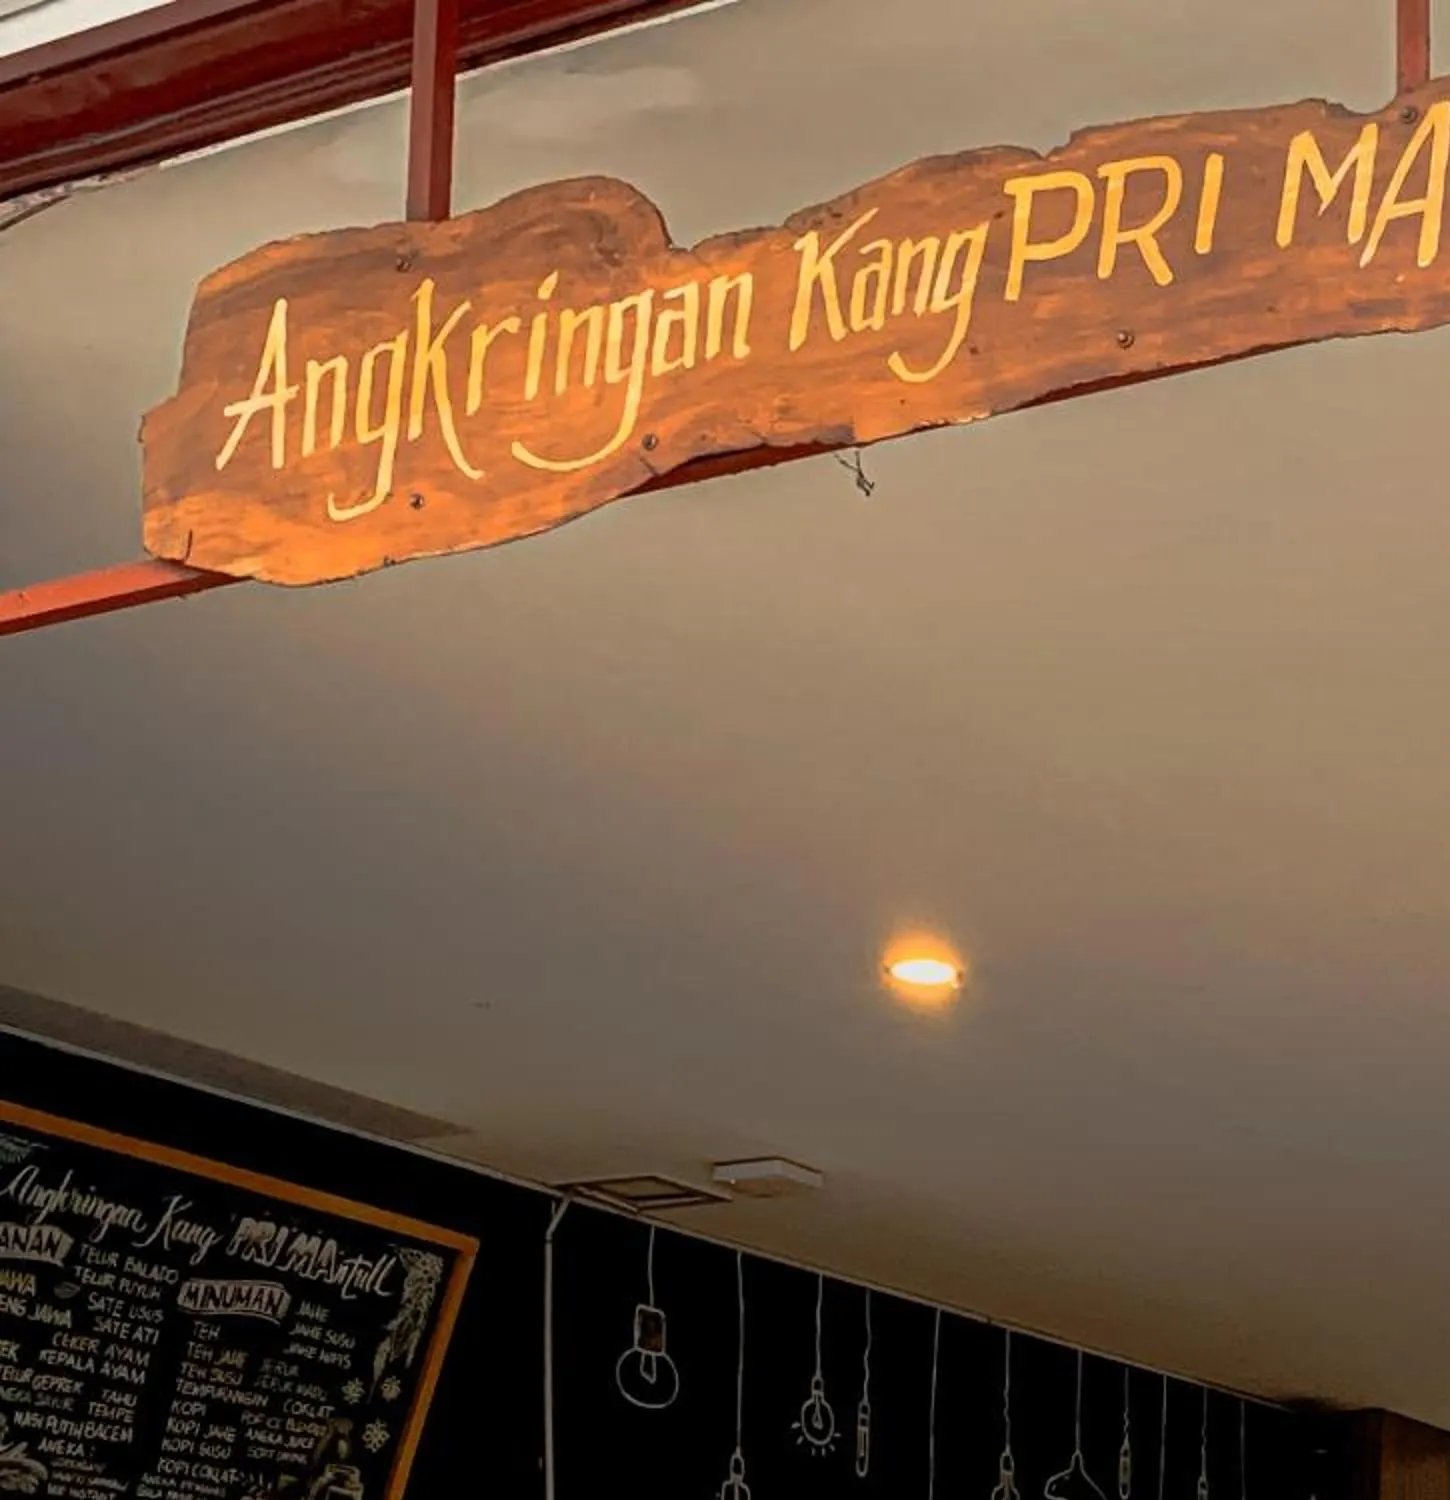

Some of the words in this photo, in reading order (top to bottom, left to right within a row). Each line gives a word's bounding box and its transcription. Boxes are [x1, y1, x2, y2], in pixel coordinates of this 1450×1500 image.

[215, 270, 755, 523] Angkringan
[788, 206, 991, 384] Kang
[1002, 152, 1226, 303] PRI
[130, 1193, 225, 1267] Kang
[87, 1290, 126, 1319] SATE
[92, 1315, 132, 1340] SATE
[131, 1326, 161, 1346] ATI
[169, 1399, 208, 1418] KOPI
